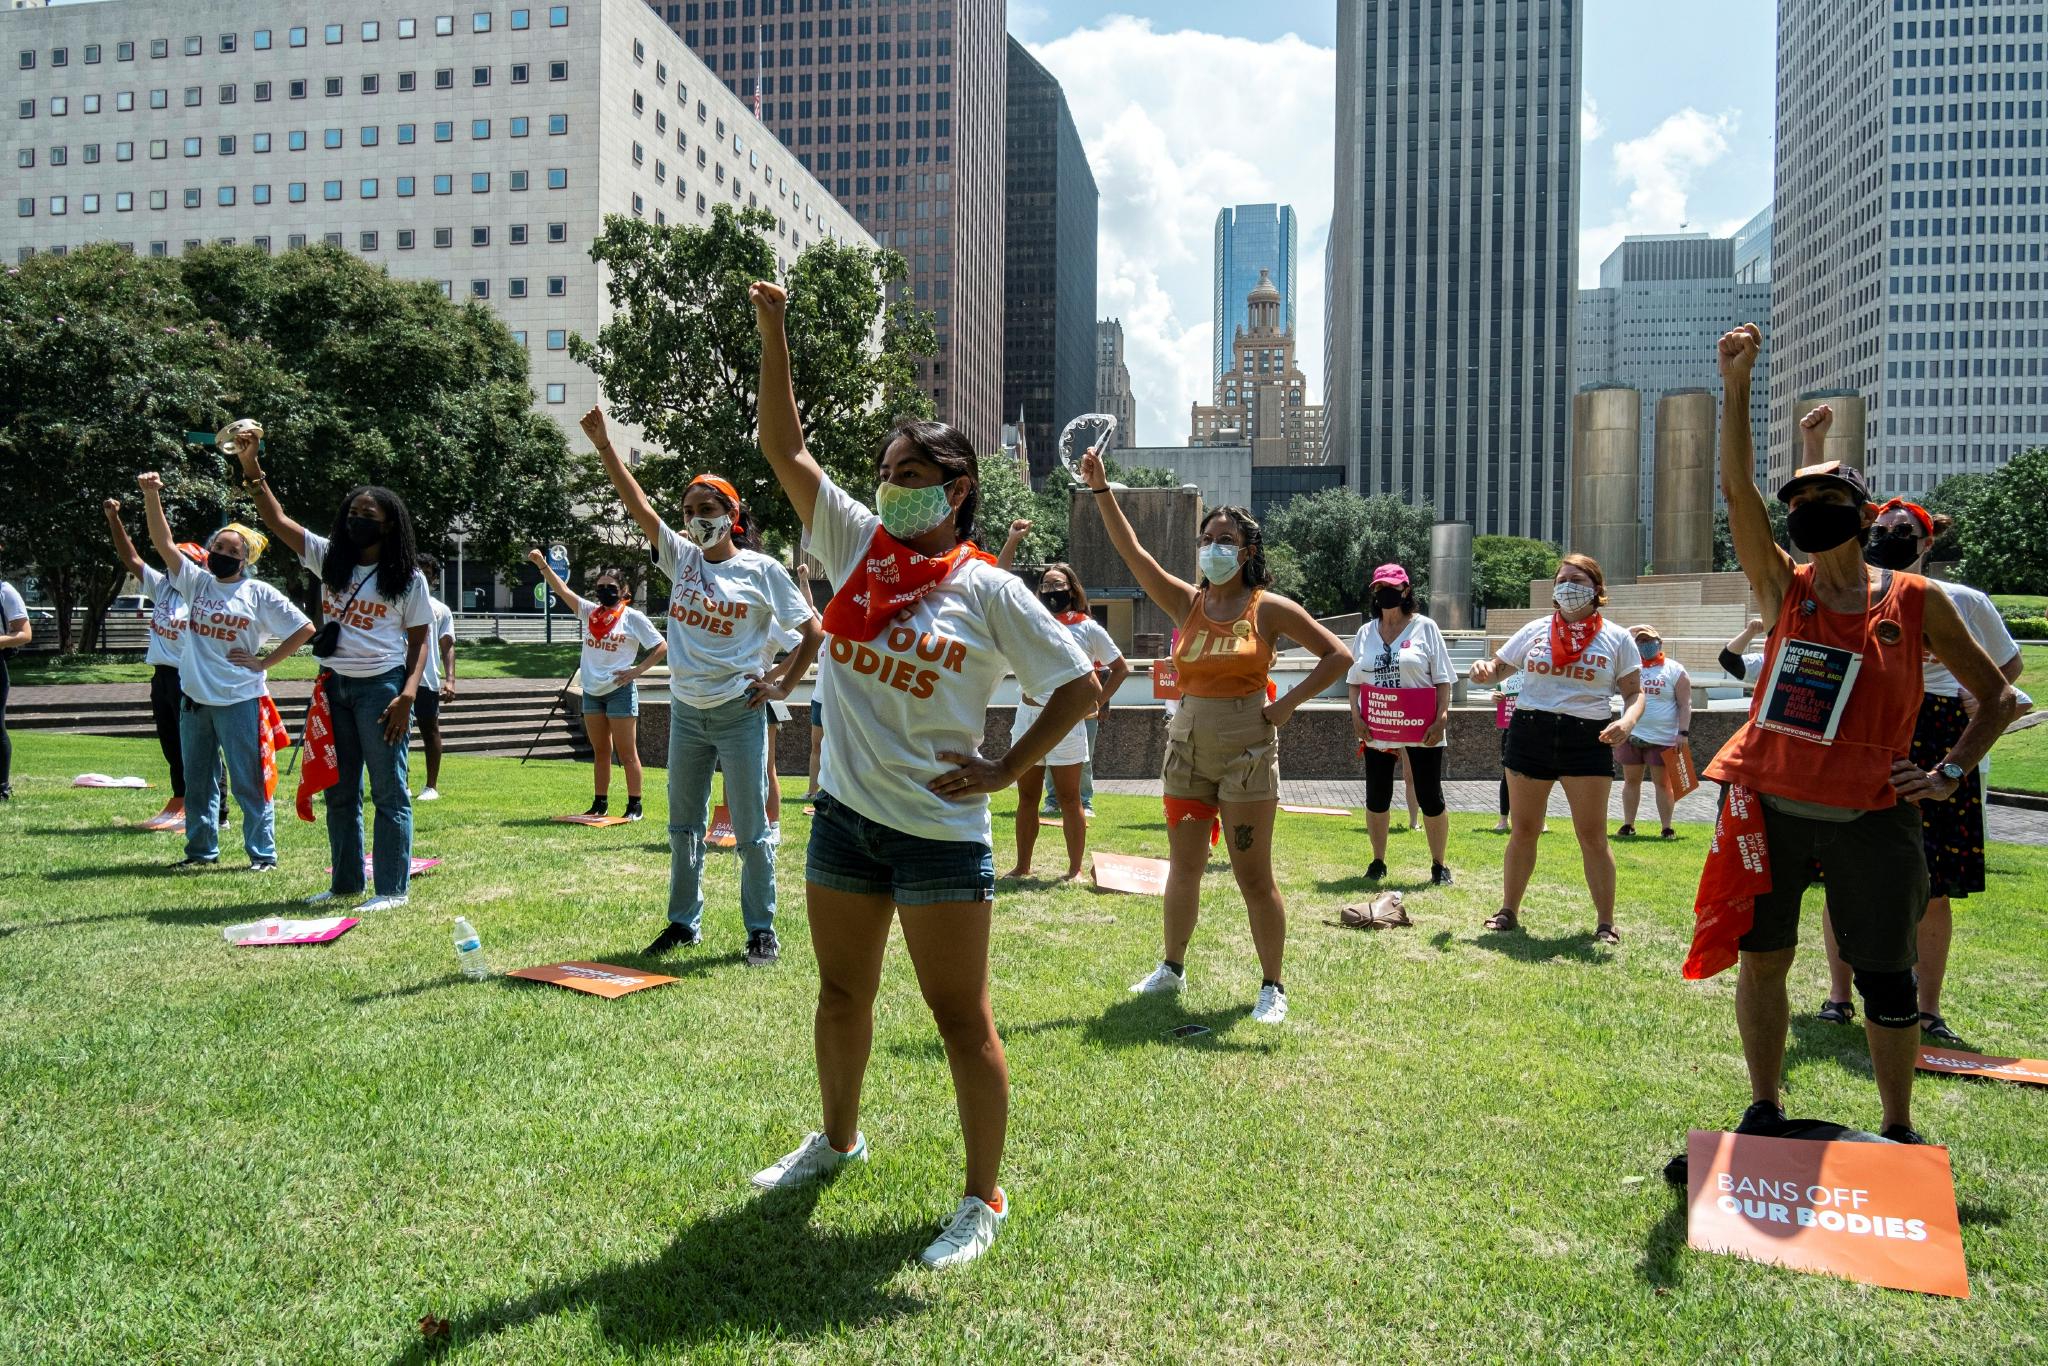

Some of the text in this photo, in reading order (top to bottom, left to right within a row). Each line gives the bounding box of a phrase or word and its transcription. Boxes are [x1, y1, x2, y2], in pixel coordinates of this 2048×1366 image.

[703, 597, 748, 619] OUR
[210, 612, 250, 631] OUR
[585, 637, 619, 652] ODIES
[887, 626, 968, 674] OUR
[1784, 654, 1801, 665] ARE
[1788, 646, 1828, 660] WOMEN
[829, 633, 941, 700] ODIES
[1582, 654, 1607, 669] UR
[1781, 662, 1799, 674] NOT
[1527, 659, 1597, 682] BODIES
[1159, 679, 1176, 688] OUR
[1374, 679, 1402, 689] CARE
[1644, 679, 1666, 688] OUR
[1777, 682, 1816, 698] WOMEN
[1368, 699, 1388, 709] WITH
[1371, 691, 1398, 702] STAND
[1788, 693, 1833, 711] ARE FULL
[1368, 707, 1405, 718] PLANNED
[1786, 701, 1820, 714] HUMAN
[1367, 714, 1425, 727] PARENTHOOD
[1764, 722, 1822, 741] www.revcom.us
[1737, 799, 1749, 820] OUR
[1754, 832, 1767, 856] BANS
[1736, 835, 1753, 870] BODIES
[1745, 833, 1764, 874] OFF OUR
[1716, 1172, 1869, 1210] BANS OFF
[1716, 1195, 1928, 1241] OUR BODIES
